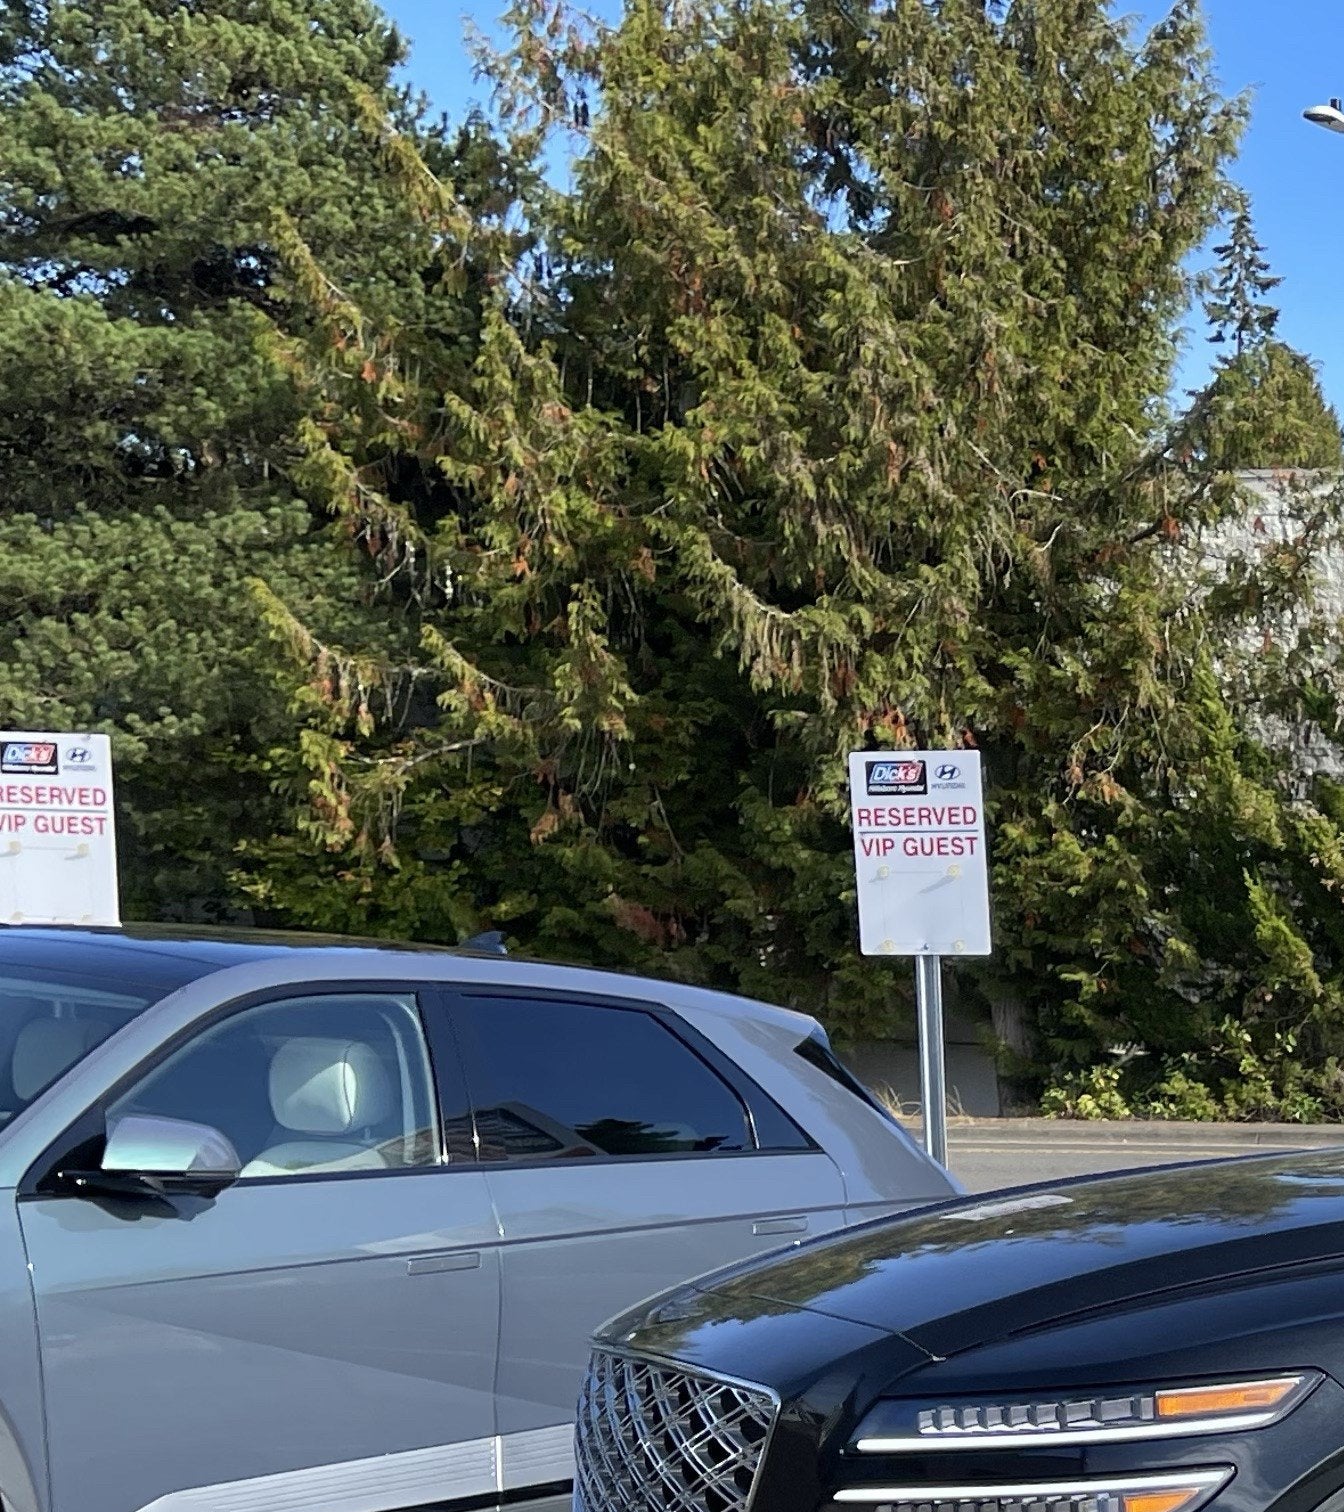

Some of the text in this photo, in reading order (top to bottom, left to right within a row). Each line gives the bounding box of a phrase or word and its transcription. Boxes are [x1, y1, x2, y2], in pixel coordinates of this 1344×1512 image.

[0, 785, 107, 806] ESERVED
[34, 814, 107, 835] GUEST
[858, 806, 977, 827] RESERVED
[861, 836, 978, 857] VIP GUEST
